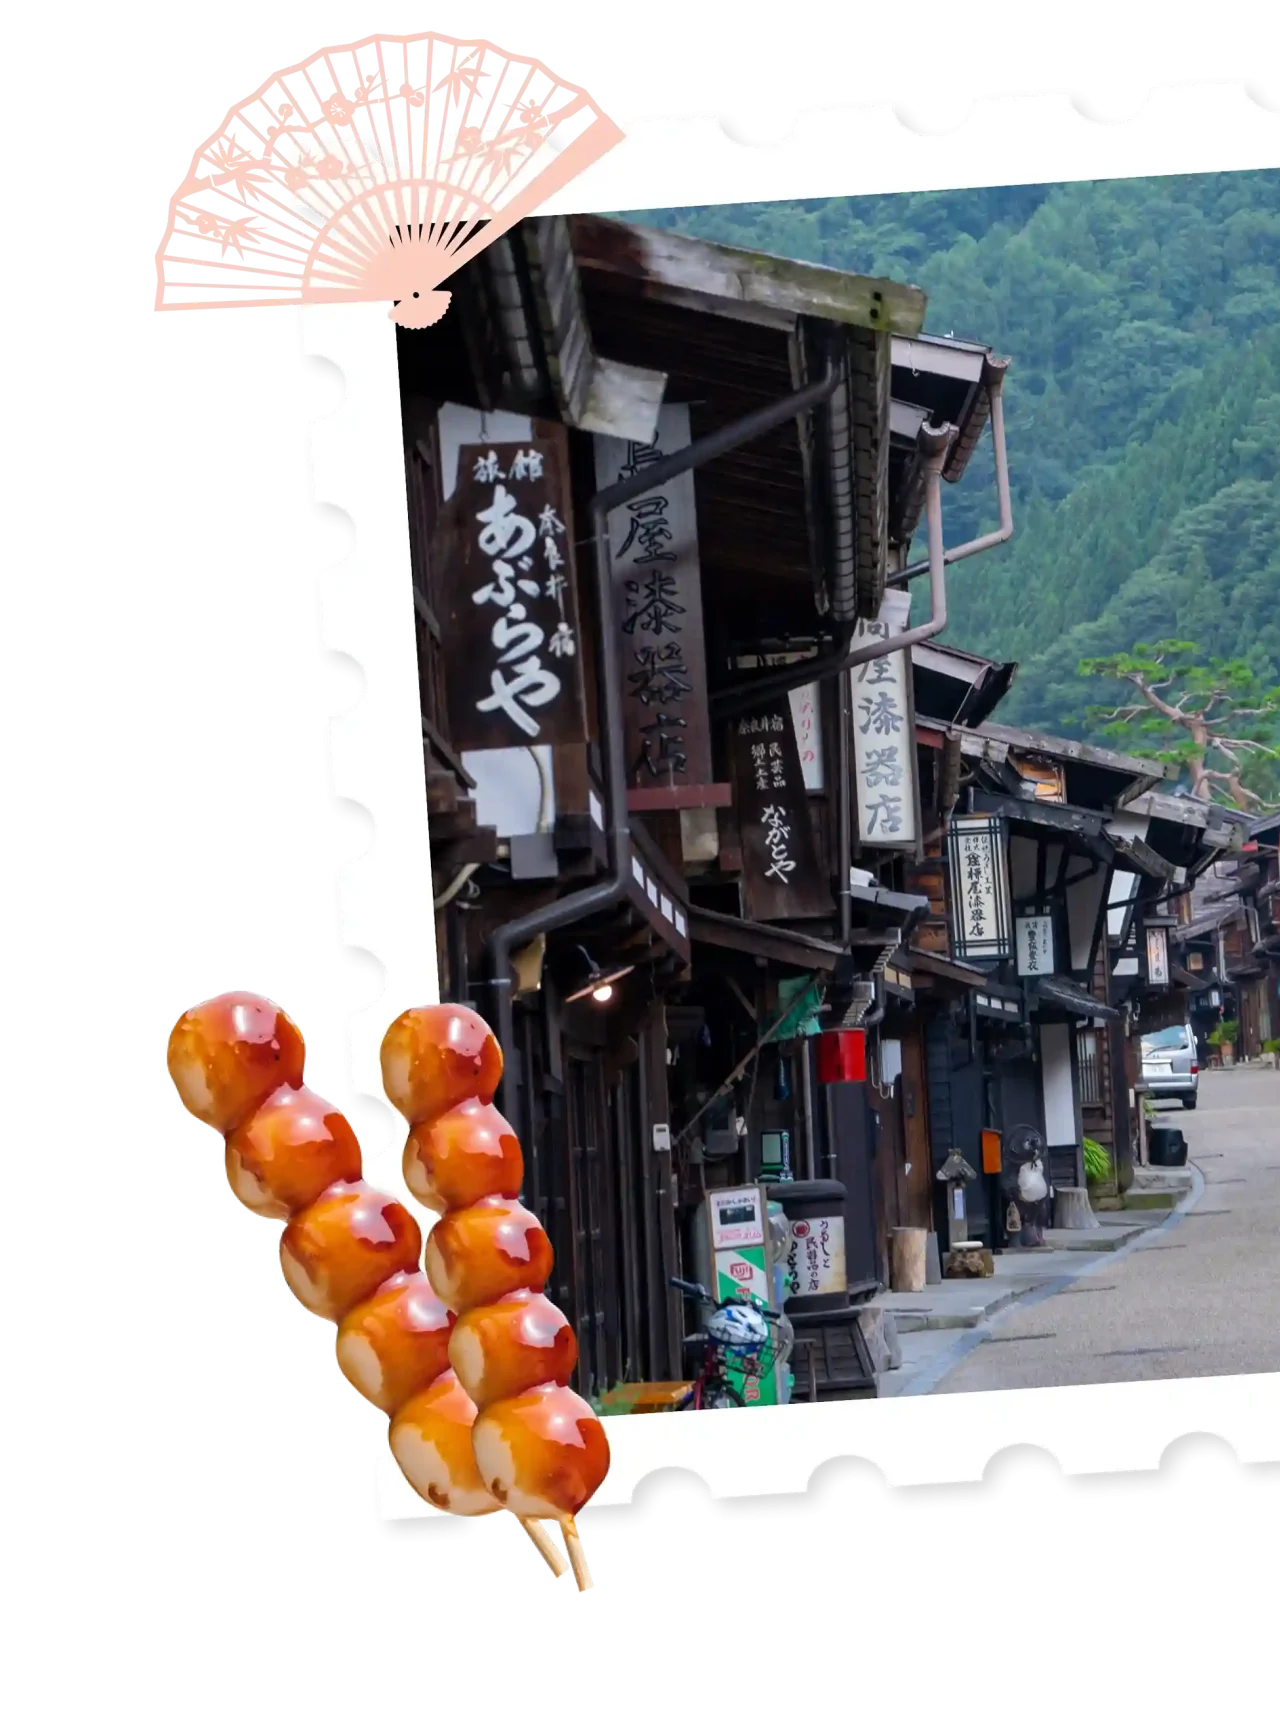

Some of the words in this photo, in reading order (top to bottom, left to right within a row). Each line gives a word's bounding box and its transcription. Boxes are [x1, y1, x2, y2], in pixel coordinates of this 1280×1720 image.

[472, 449, 544, 483] 旅館
[472, 484, 562, 738] あぶらや
[538, 503, 577, 658] 奈良井宿
[761, 804, 797, 884] ながとや
